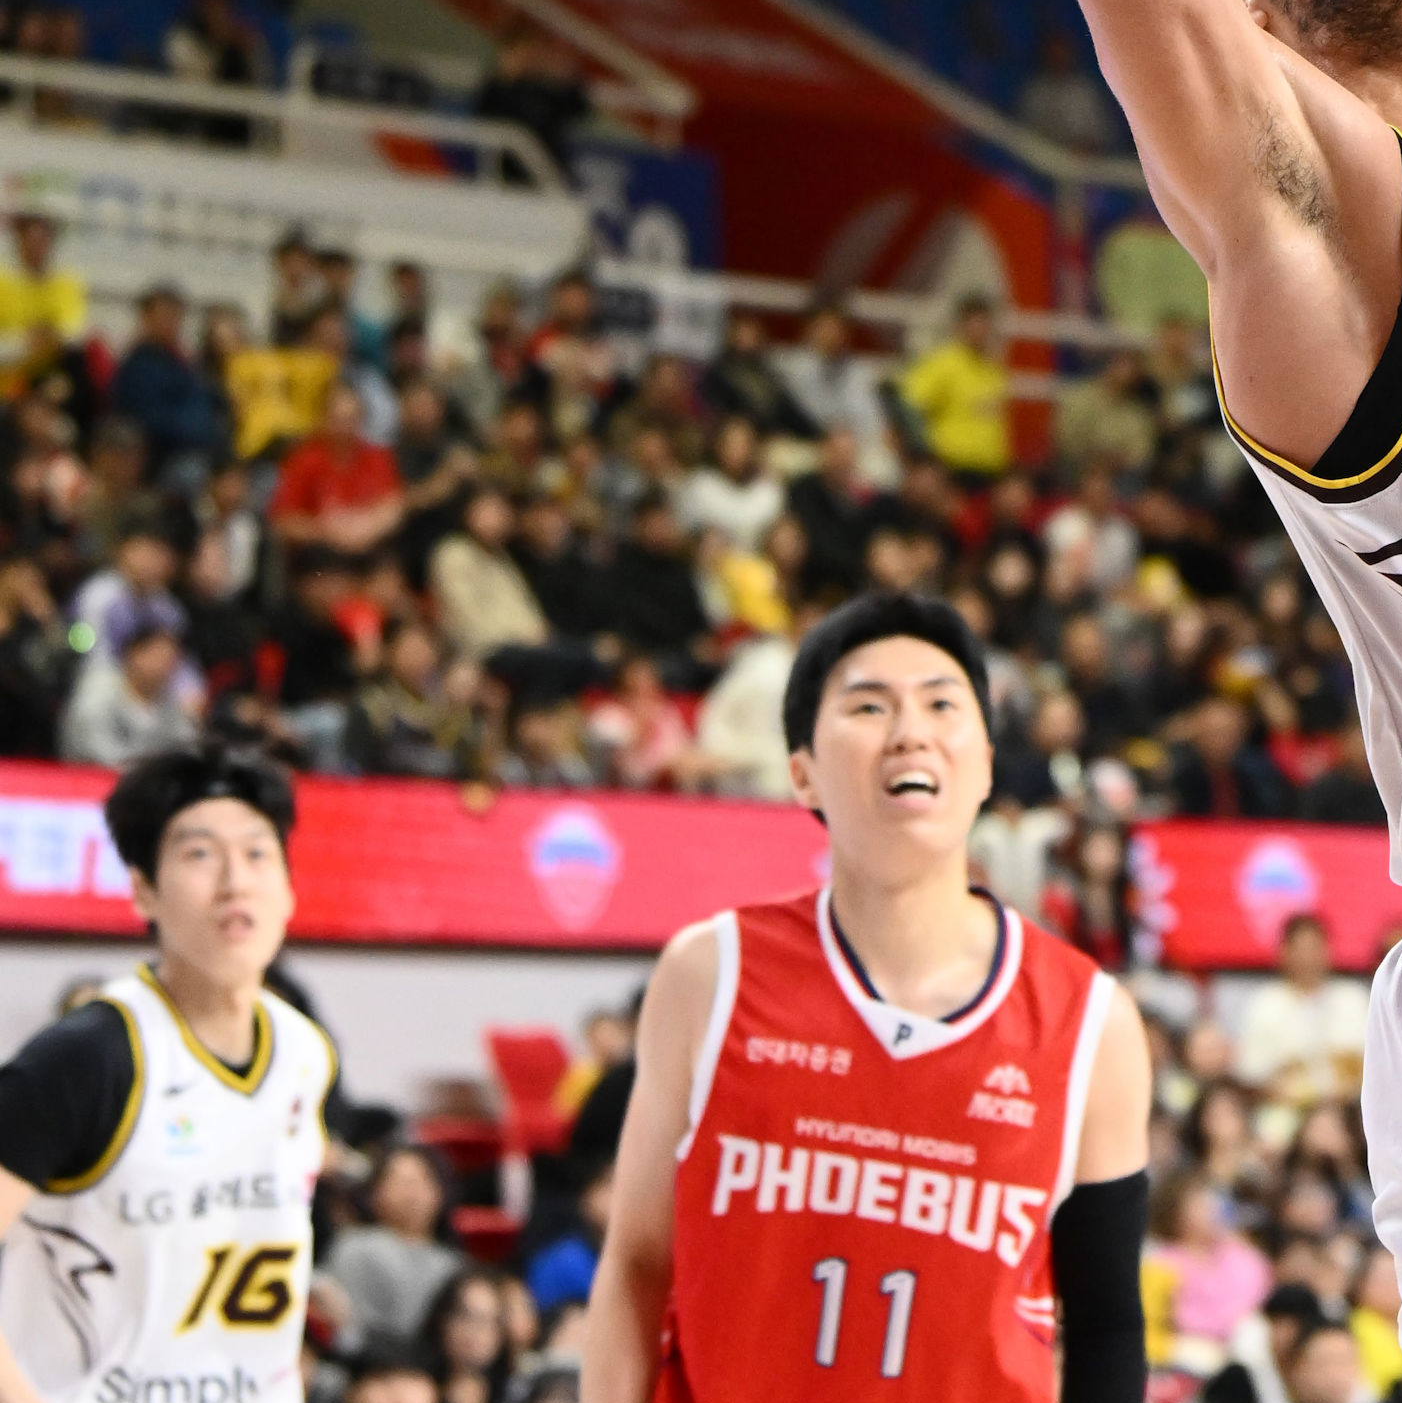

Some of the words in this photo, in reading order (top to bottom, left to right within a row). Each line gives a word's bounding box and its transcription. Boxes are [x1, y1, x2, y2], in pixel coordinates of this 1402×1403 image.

[795, 1117, 900, 1151] HYUNDAI
[902, 1134, 977, 1166] MOBIS
[711, 1133, 1048, 1269] PHOEBUS
[174, 1241, 303, 1336] 16
[813, 1256, 917, 1379] 11
